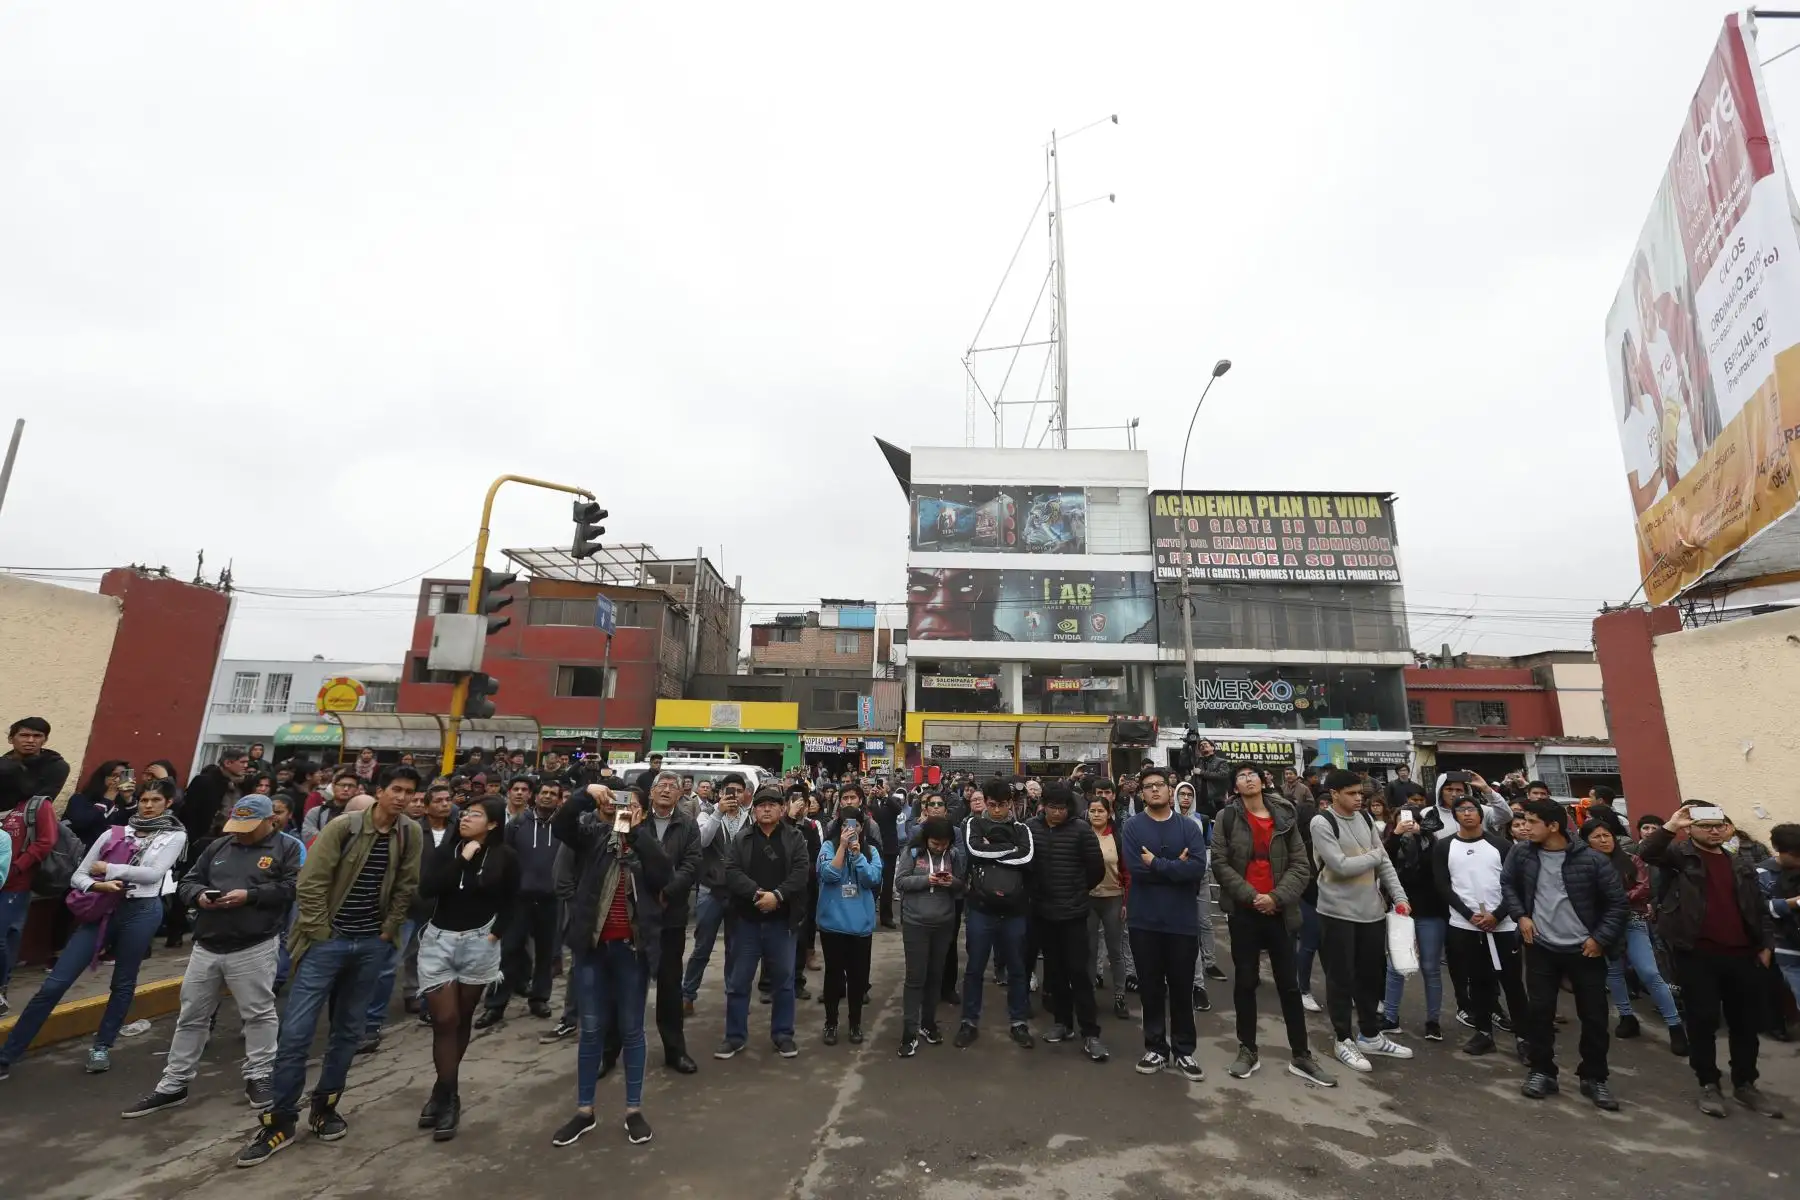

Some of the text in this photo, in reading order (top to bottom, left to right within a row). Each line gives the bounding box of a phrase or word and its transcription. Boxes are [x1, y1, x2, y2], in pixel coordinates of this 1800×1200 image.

[1719, 237, 1746, 284] CICLOS
[1156, 495, 1382, 518] ACADEMIA PLAN DE VIDA
[1210, 519, 1272, 533] GASTE
[1282, 520, 1305, 534] EN
[1315, 520, 1366, 534] VANO
[1213, 536, 1277, 550] EXAMEN
[1282, 537, 1303, 550] DE
[1308, 536, 1390, 551] ADMISIÓN
[1198, 552, 1280, 566] EVALÚE
[1284, 554, 1298, 566] A
[1305, 554, 1335, 566] SU
[1342, 554, 1394, 567] HIJO
[1248, 569, 1288, 580] INFORMES
[1288, 570, 1294, 580] Y
[1295, 570, 1325, 580] CLASES
[1326, 570, 1336, 580] EN
[1337, 570, 1346, 580] EL
[1348, 570, 1378, 580] PRIMER
[1379, 570, 1398, 580] PISO
[1184, 700, 1294, 712] rstaurante-lounge
[865, 741, 883, 750] LIBROS
[1222, 742, 1292, 753] ACADEMIA
